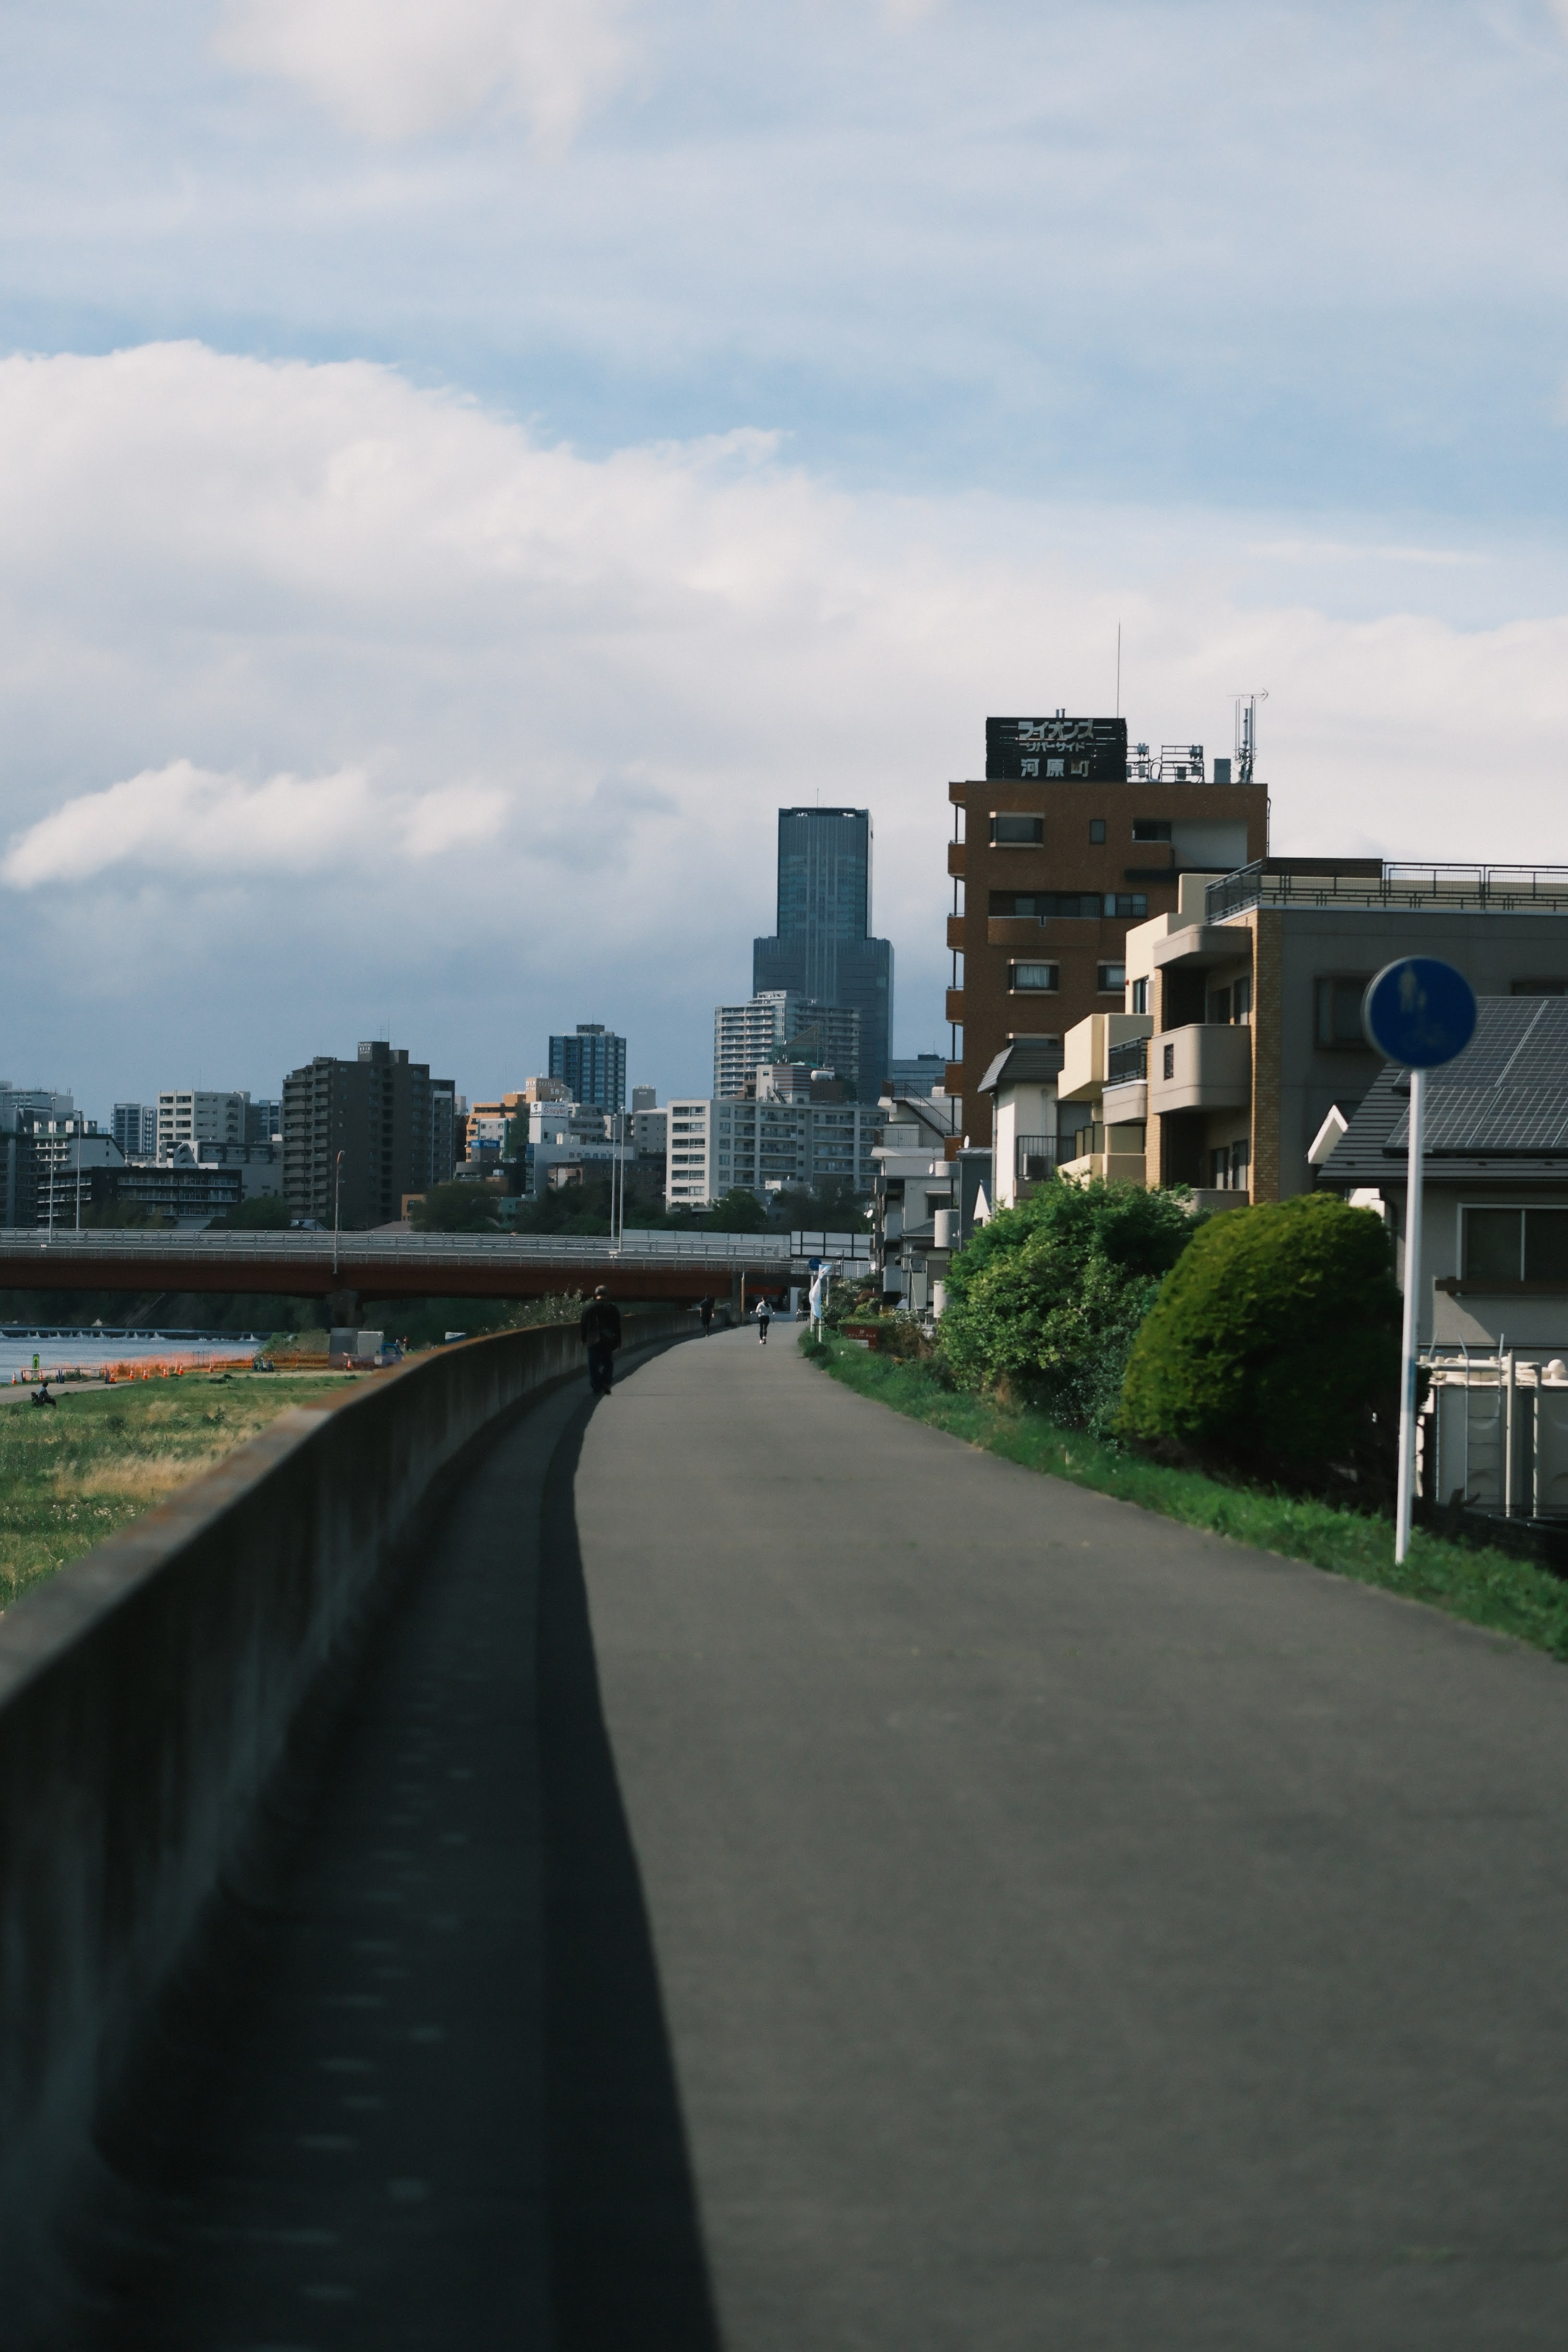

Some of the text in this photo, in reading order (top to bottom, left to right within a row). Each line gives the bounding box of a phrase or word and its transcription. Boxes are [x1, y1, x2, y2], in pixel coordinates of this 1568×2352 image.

[1018, 719, 1094, 739] ライオンズ
[1021, 758, 1090, 777] 河原町
